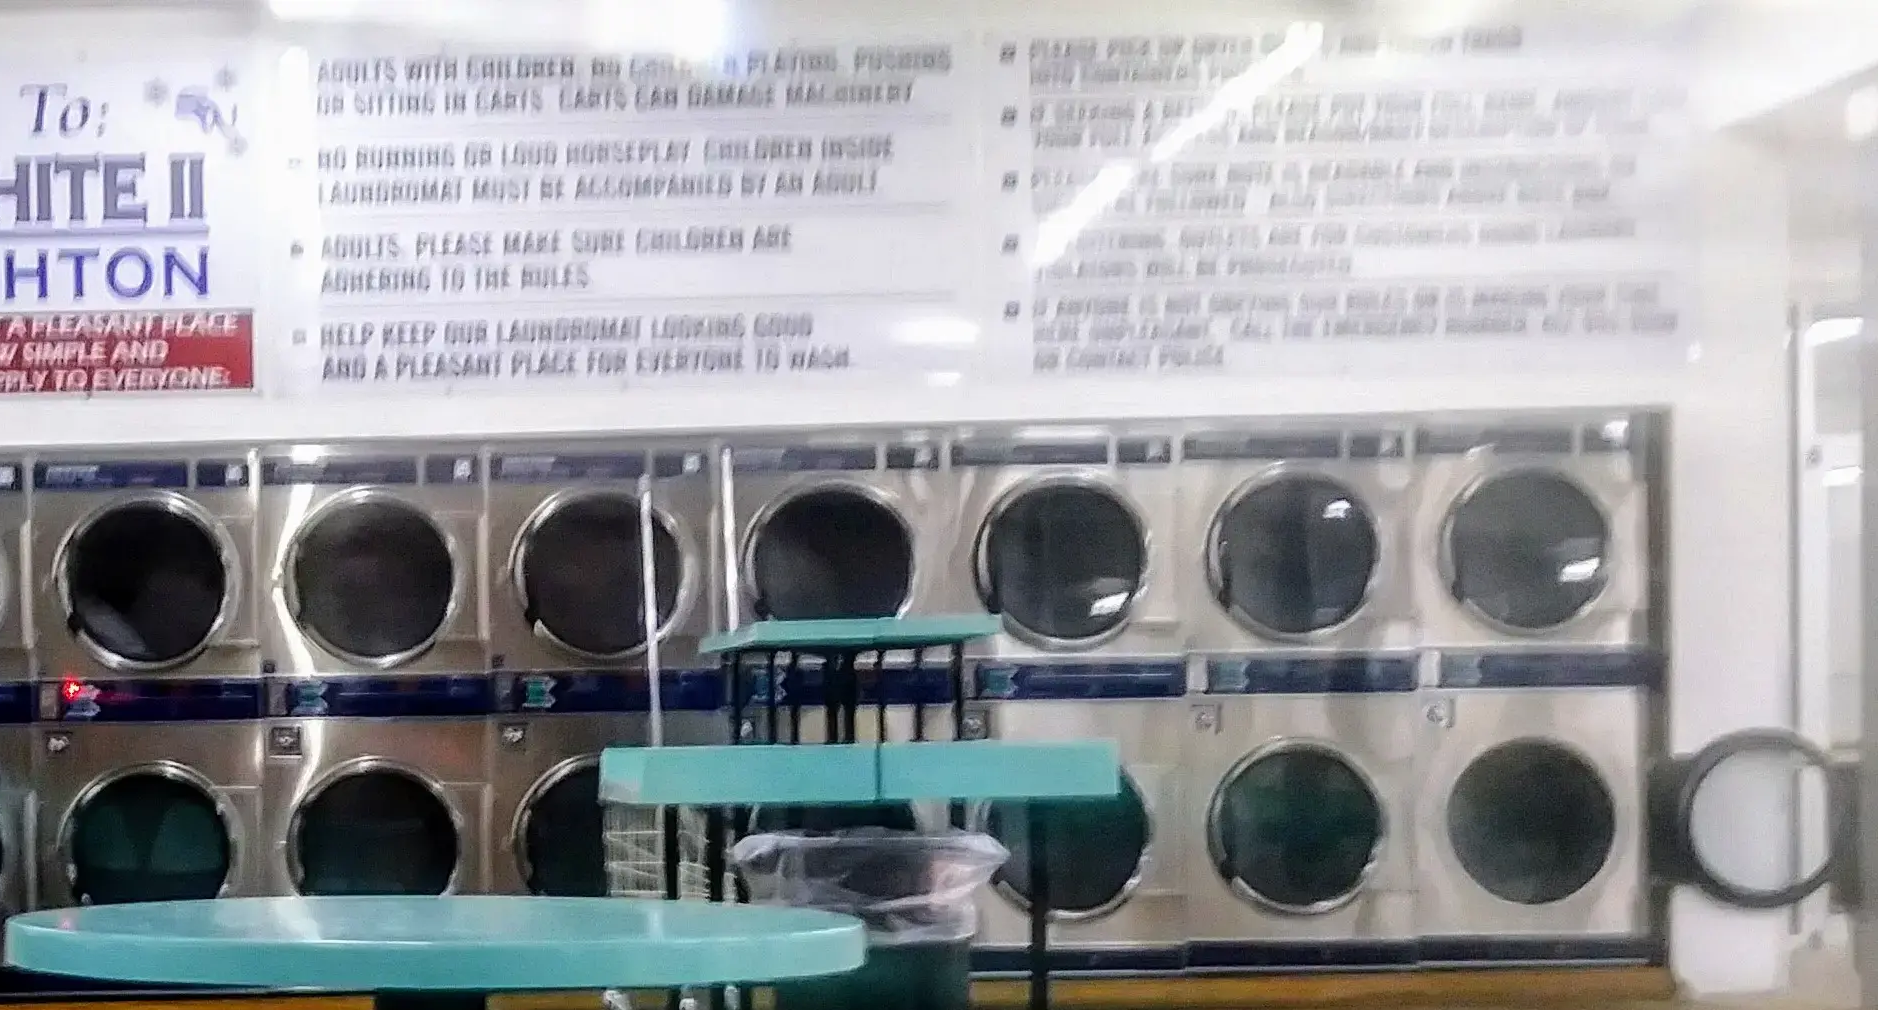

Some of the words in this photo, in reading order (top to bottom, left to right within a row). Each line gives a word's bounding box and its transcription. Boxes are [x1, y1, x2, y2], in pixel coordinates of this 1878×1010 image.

[20, 83, 109, 138] To:
[168, 152, 206, 219] II
[22, 341, 107, 368] SIMPLE
[109, 340, 170, 366] AND
[54, 368, 89, 393] TO
